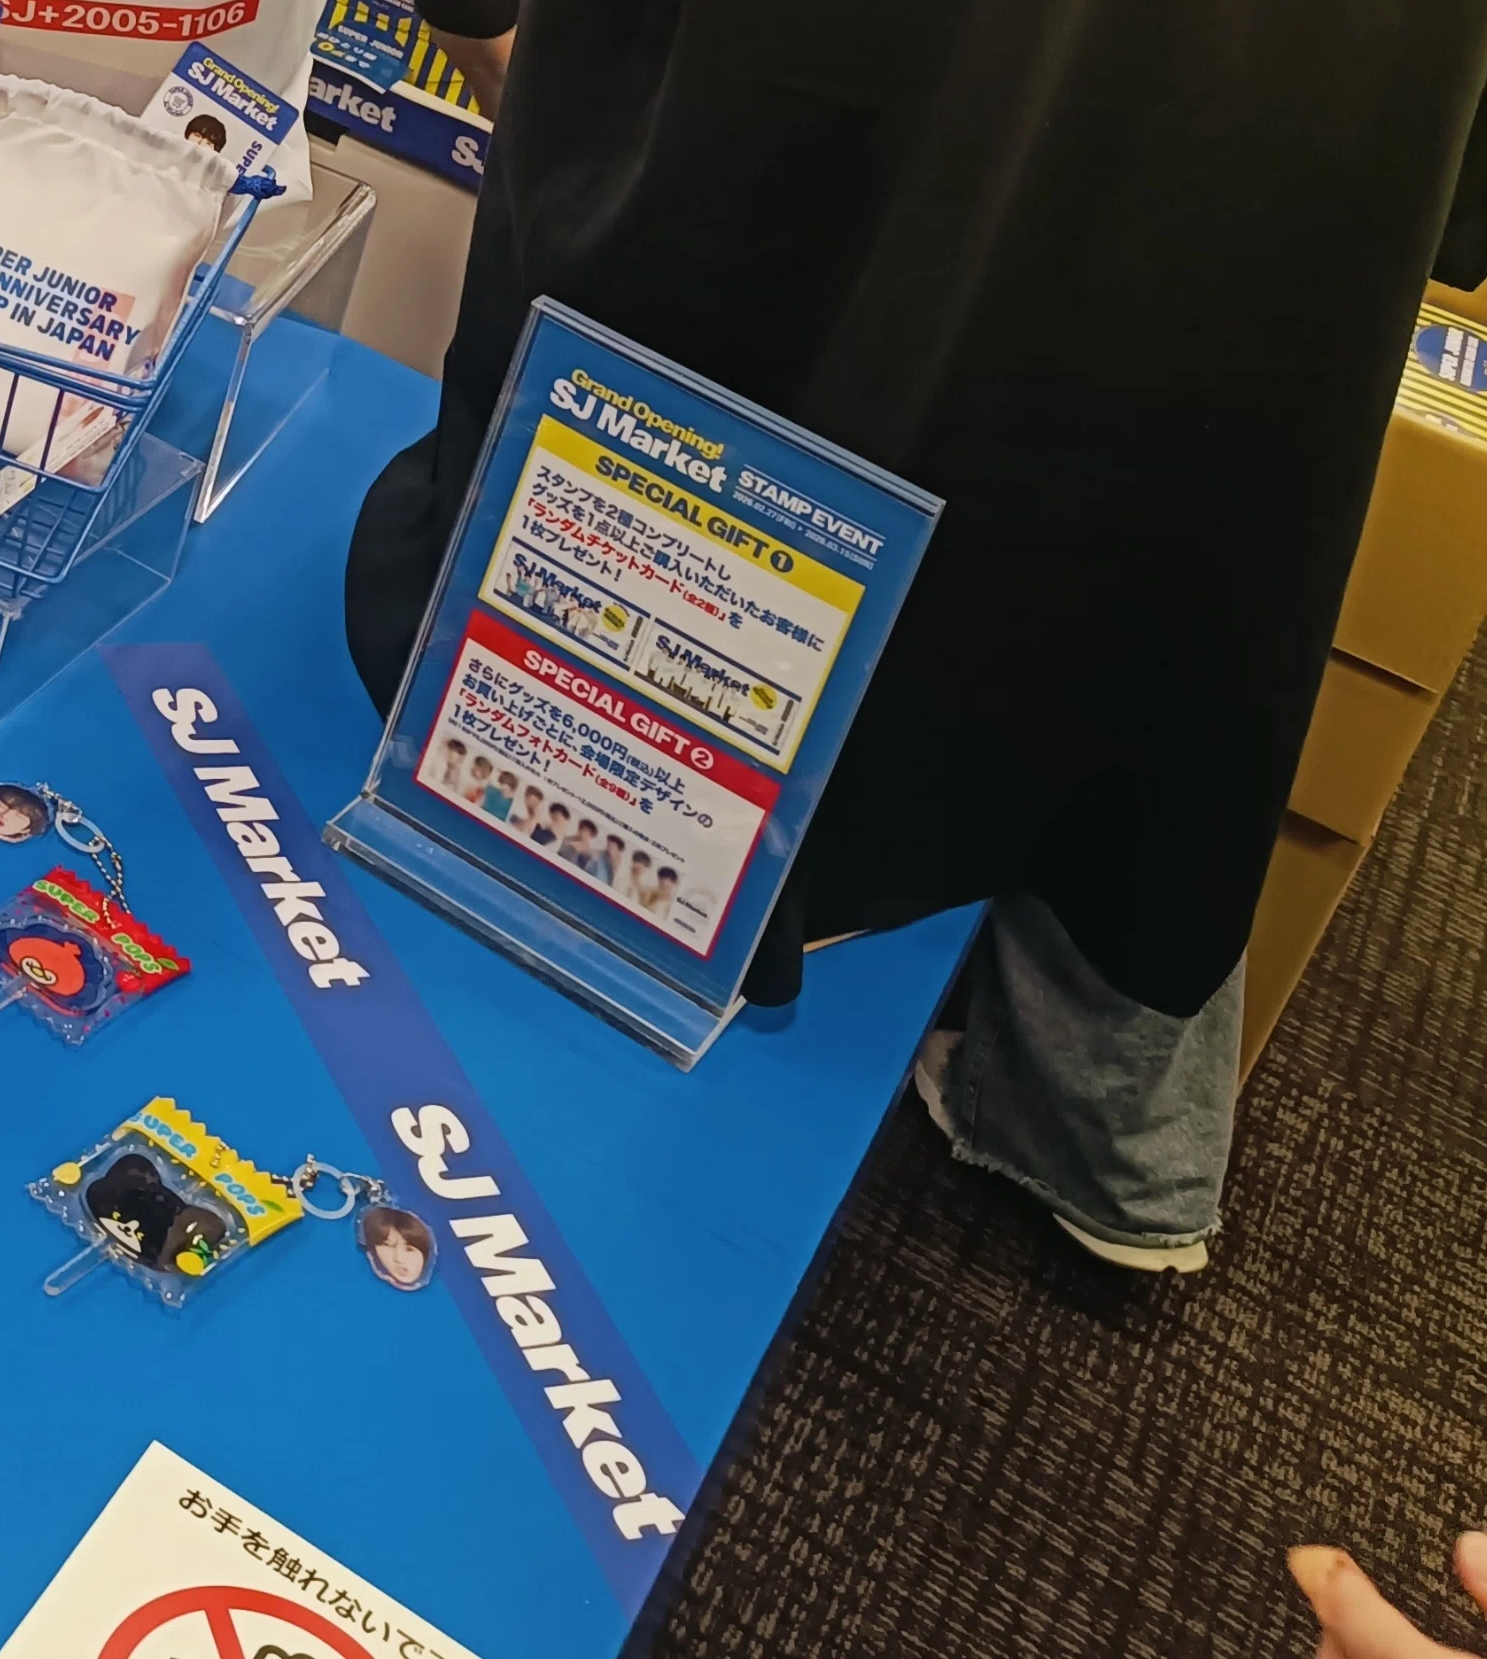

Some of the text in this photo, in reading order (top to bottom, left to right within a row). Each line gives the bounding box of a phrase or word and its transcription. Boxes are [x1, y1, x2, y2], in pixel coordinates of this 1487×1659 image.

[202, 57, 281, 115] Grand Opening!
[338, 24, 369, 44] SUPER
[369, 39, 405, 60] JUNIOR
[187, 61, 215, 86] SJ
[210, 81, 278, 133] Market
[308, 75, 398, 134] arket
[235, 140, 263, 176] SUPE
[10, 303, 37, 328] IN
[36, 316, 117, 363] JAPAN
[32, 266, 118, 313] JUNIOR
[549, 378, 729, 494] SJ Market
[570, 368, 725, 460] Grand Opening!
[595, 455, 770, 561] SPECIAL GIFT
[738, 469, 885, 555] STAMP EVENT
[523, 649, 627, 726] SPECIAL
[629, 709, 692, 758] GIFT
[151, 686, 371, 991] SJ Market
[30, 878, 163, 976] SUPER POPS
[129, 1111, 267, 1219] SUPER POPS
[389, 1103, 687, 1542] SJ Market
[178, 1487, 450, 1659] お手を触れないで
